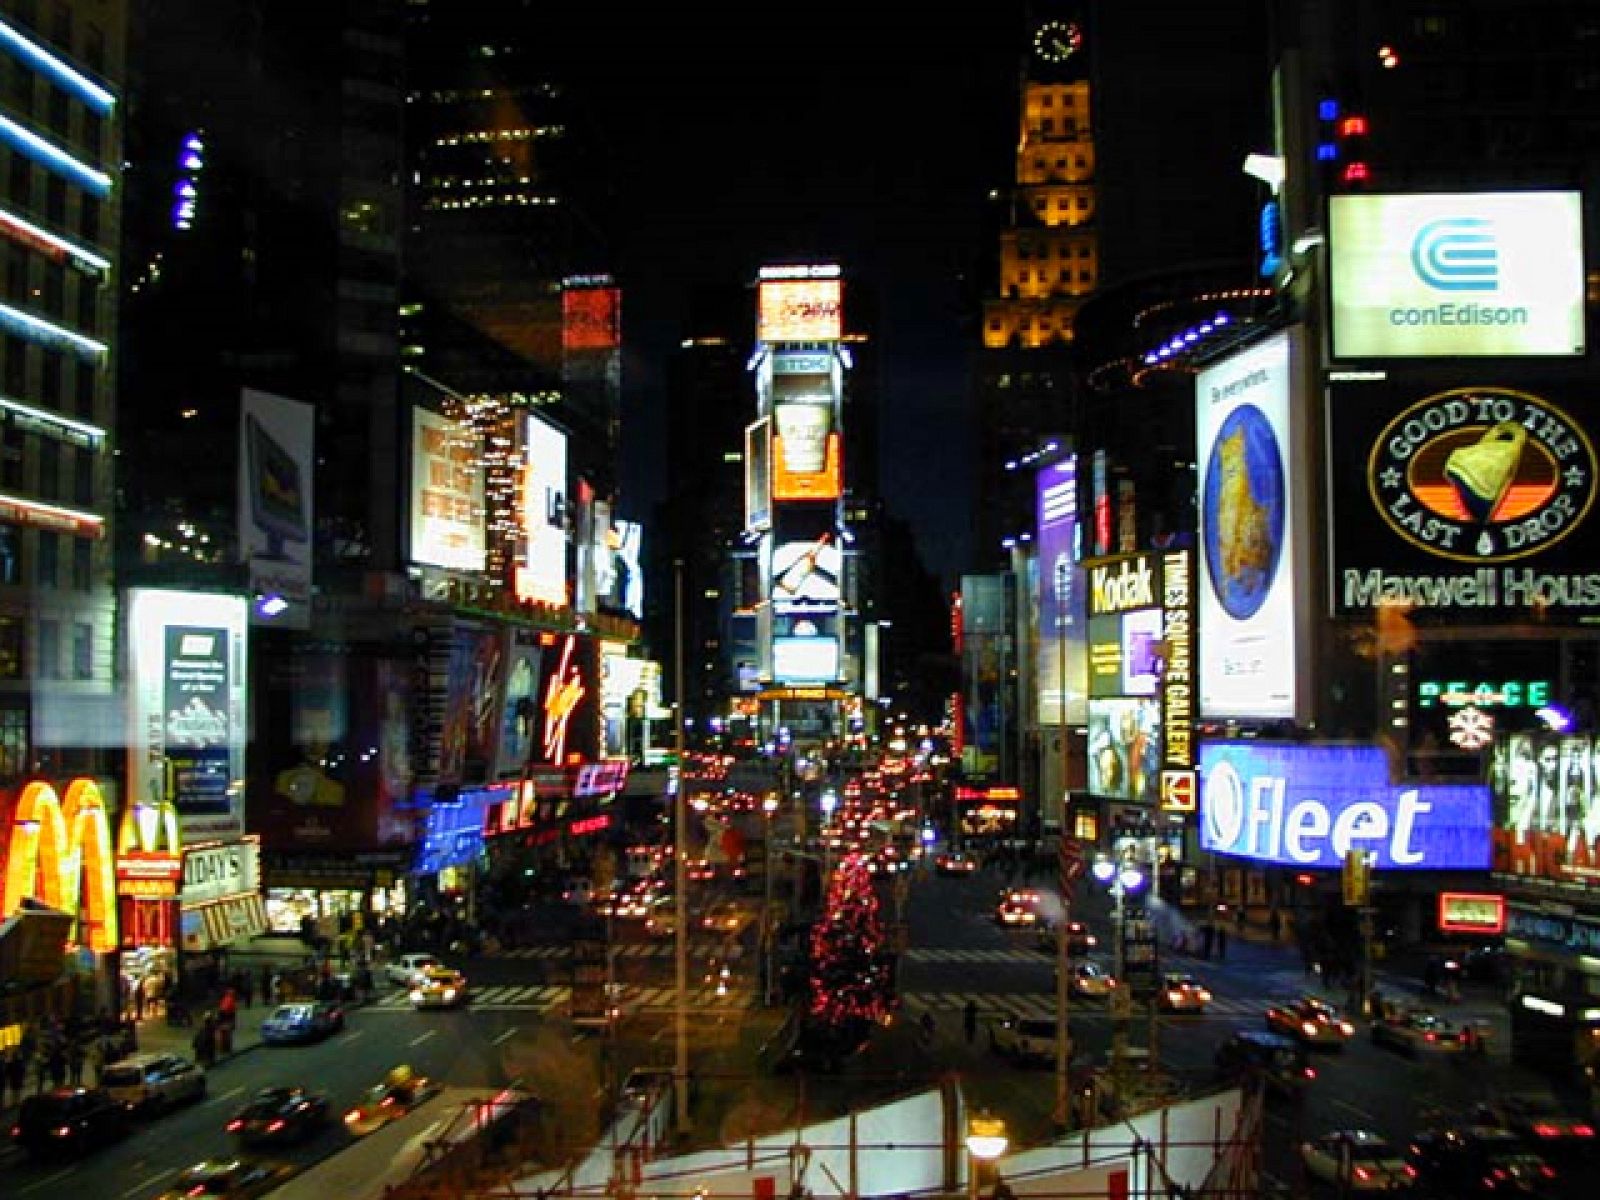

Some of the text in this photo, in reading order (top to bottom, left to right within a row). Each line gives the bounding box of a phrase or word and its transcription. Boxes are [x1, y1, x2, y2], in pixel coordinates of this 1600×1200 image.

[1389, 304, 1528, 326] conEdison
[1389, 399, 1579, 459] GOOD TO THE
[1389, 493, 1576, 548] LAST DROP
[1091, 557, 1153, 613] Kodak
[1164, 550, 1189, 607] TIMES
[1344, 568, 1497, 607] Maxwell
[1419, 682, 1549, 706] PEACE
[1164, 684, 1191, 766] GALLERY
[1249, 775, 1432, 865] Fleet
